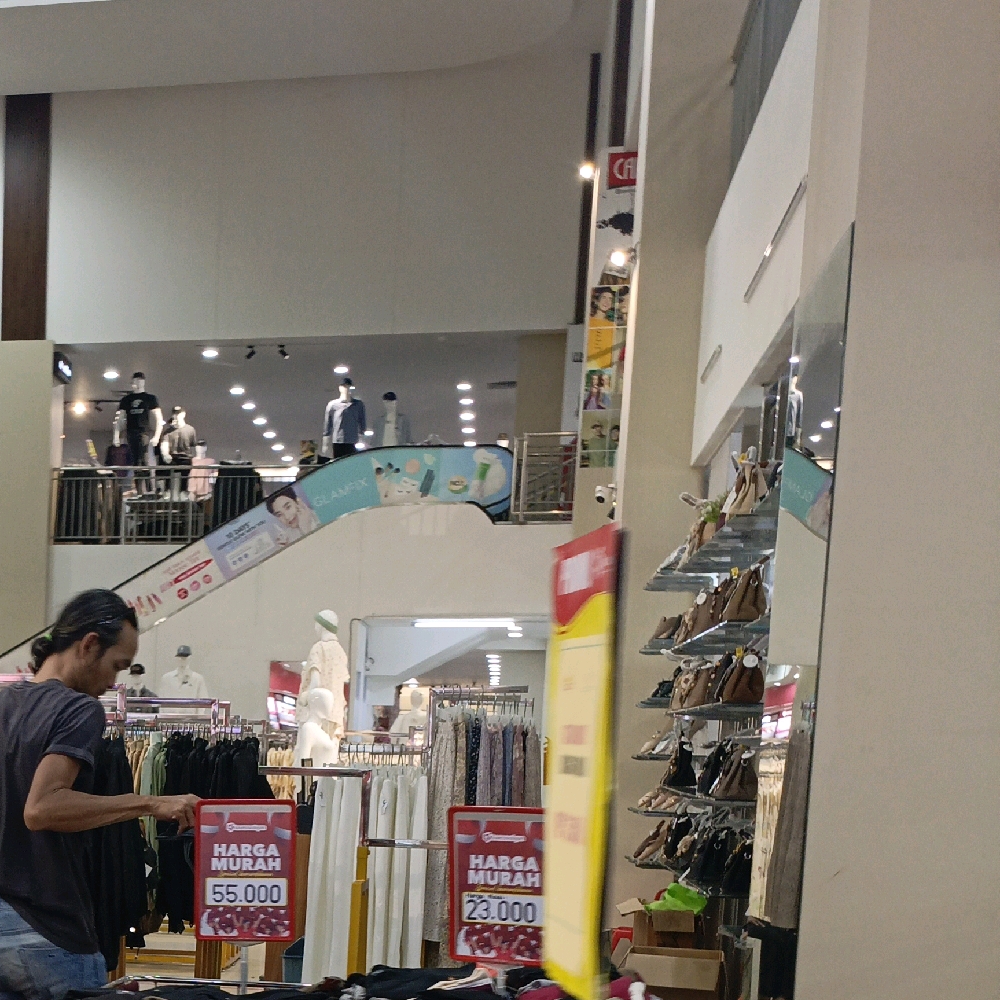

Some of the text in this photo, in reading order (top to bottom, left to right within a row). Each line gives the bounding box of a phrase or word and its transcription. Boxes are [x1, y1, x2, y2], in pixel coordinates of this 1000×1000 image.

[213, 843, 281, 857] HARGA
[211, 857, 282, 871] MURAH
[469, 855, 540, 871] HARGA
[467, 870, 542, 887] MURAH
[212, 884, 281, 903] 55.000
[466, 899, 537, 923] 23.000
